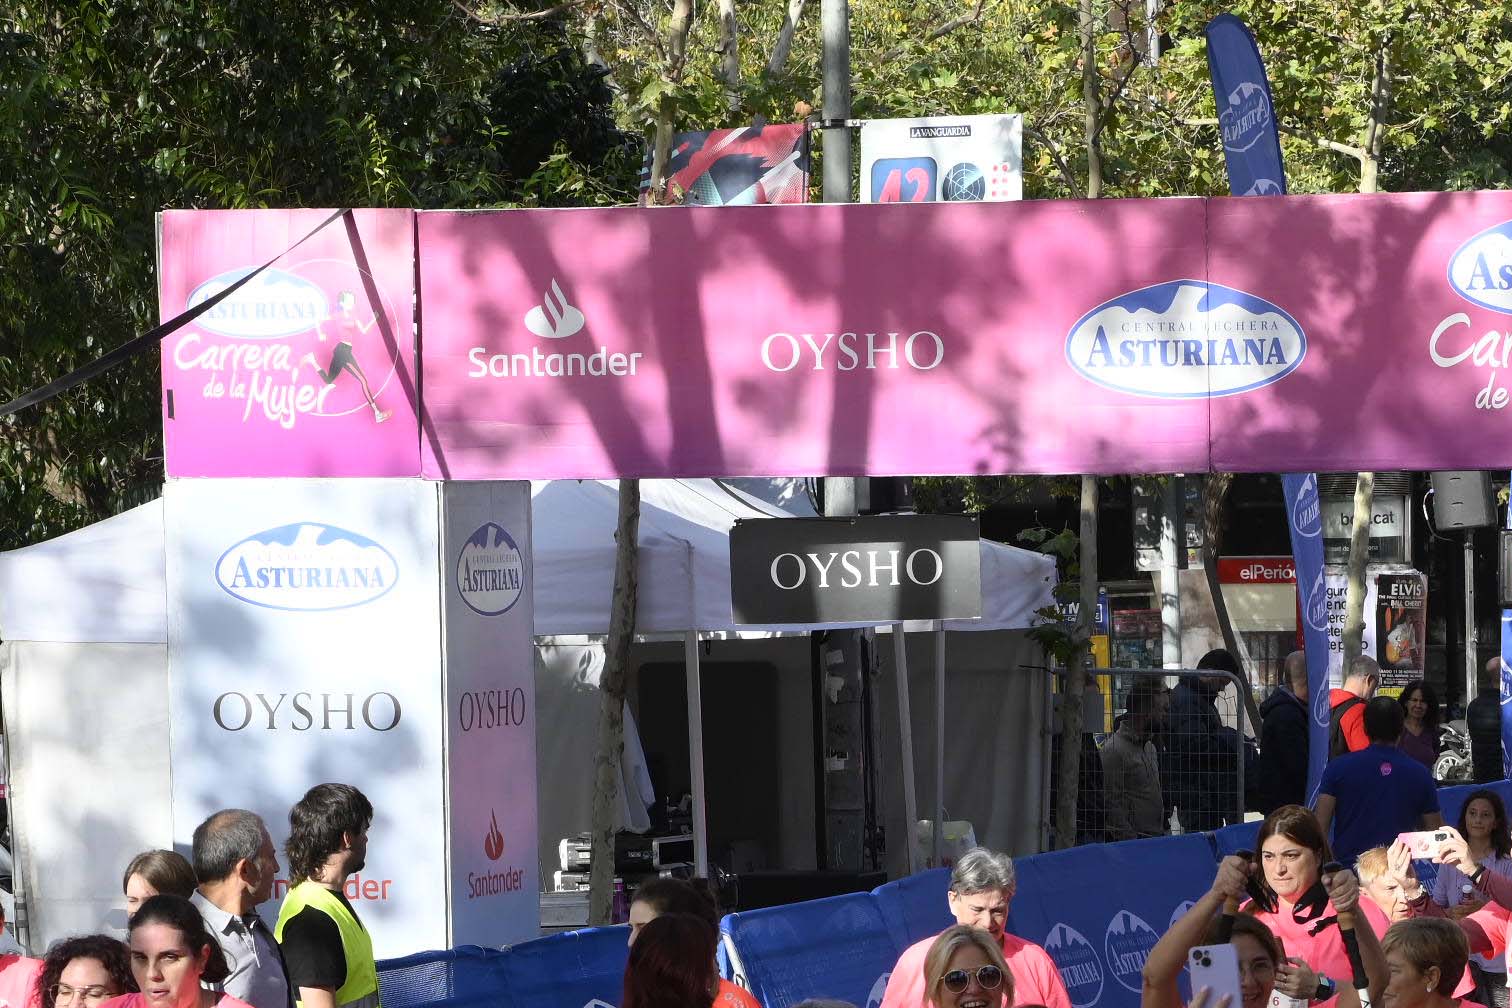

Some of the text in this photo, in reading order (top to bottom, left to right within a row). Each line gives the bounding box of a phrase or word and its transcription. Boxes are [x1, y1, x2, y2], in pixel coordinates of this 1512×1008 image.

[921, 126, 970, 137] VANGUARDIA
[174, 333, 292, 371] Carrera
[468, 345, 642, 379] Santander
[760, 330, 944, 372] OYSHO
[1085, 325, 1288, 368] ASTURIANA
[203, 366, 336, 429] de la Mujer
[1475, 371, 1509, 410] de
[230, 556, 385, 589] ASTURIANA
[463, 558, 520, 593] ASTURIANA
[770, 548, 944, 590] OYSHO
[1391, 583, 1422, 596] ELVIS
[213, 691, 402, 732] OYSHO
[459, 687, 526, 732] OYSHO
[468, 867, 525, 901] Santander
[1062, 966, 1100, 988] STURIANA
